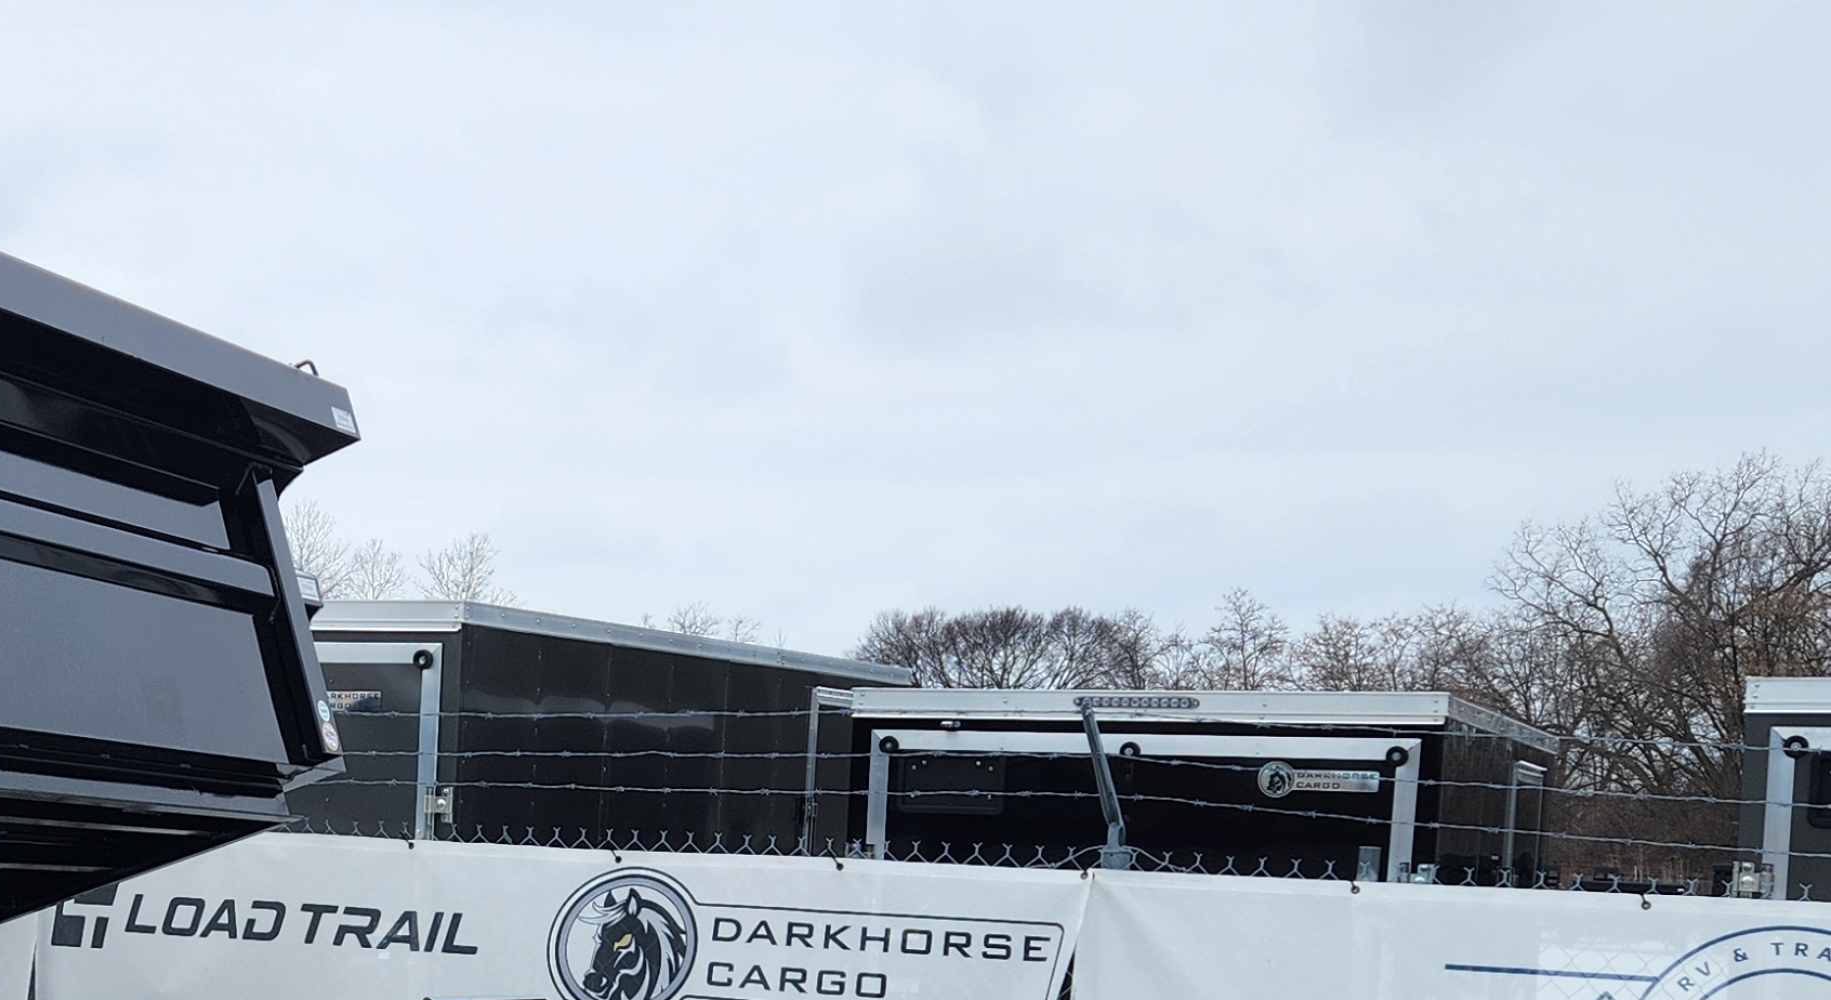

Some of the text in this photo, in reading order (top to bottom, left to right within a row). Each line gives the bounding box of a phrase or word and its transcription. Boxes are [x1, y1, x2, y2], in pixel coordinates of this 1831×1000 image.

[1295, 781, 1341, 790] CARGO
[125, 894, 478, 955] LOAD TRAIL
[711, 917, 1052, 962] DARKHORSE
[706, 961, 888, 999] CARGO
[1676, 961, 1712, 992] RV
[1732, 947, 1749, 963] &
